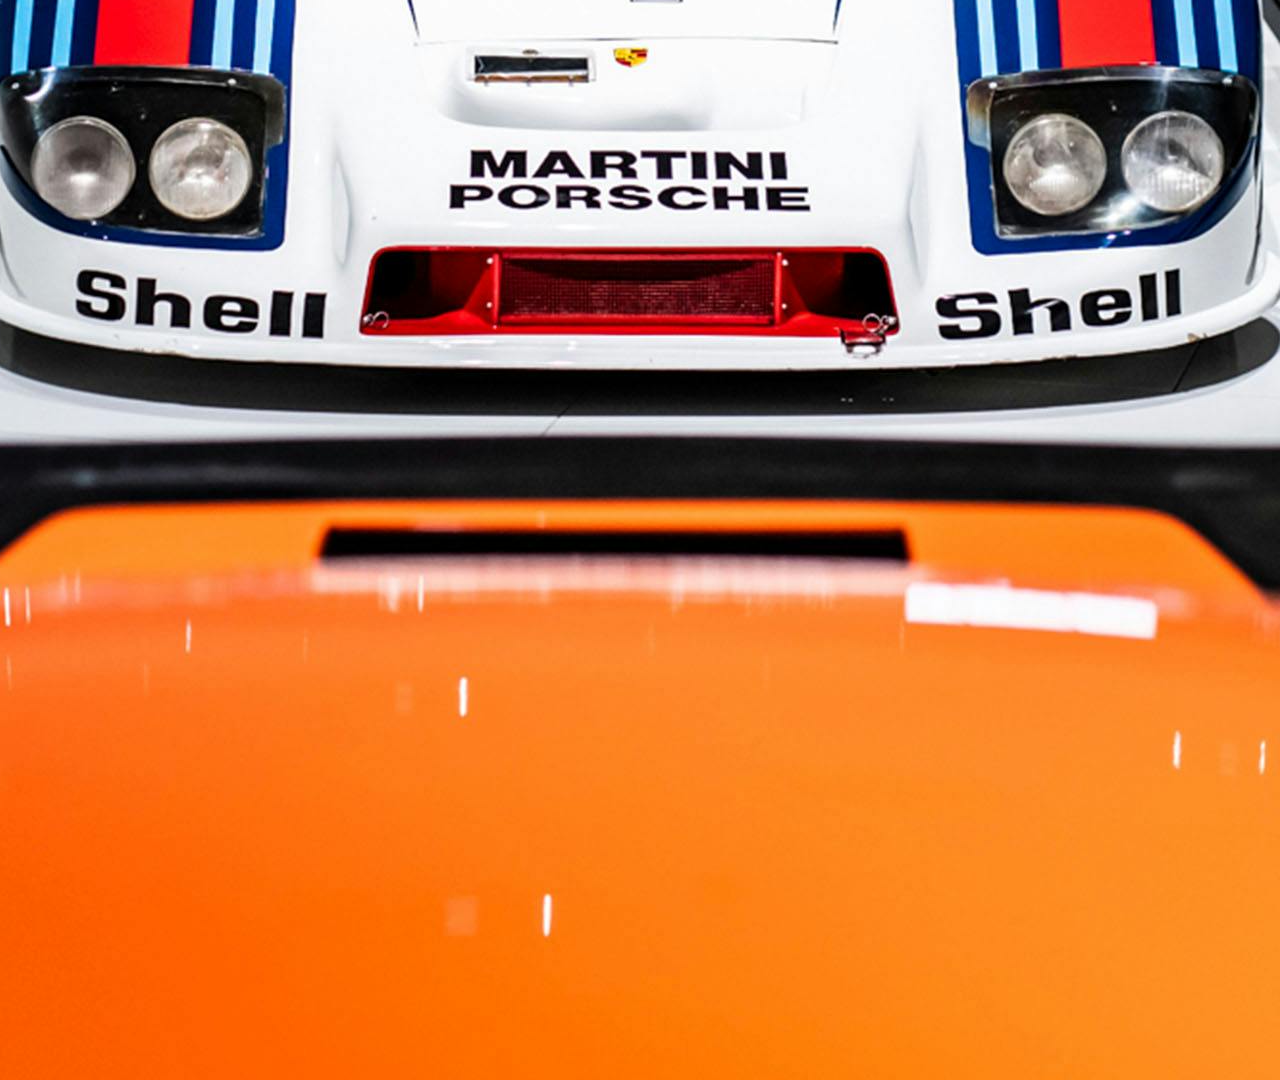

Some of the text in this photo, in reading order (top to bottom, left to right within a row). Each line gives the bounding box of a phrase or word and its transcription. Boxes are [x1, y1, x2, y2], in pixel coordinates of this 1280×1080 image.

[469, 149, 789, 181] MARTINI
[448, 183, 811, 213] PORSCHE
[74, 268, 327, 340] Shell
[934, 268, 1183, 340] Shell
